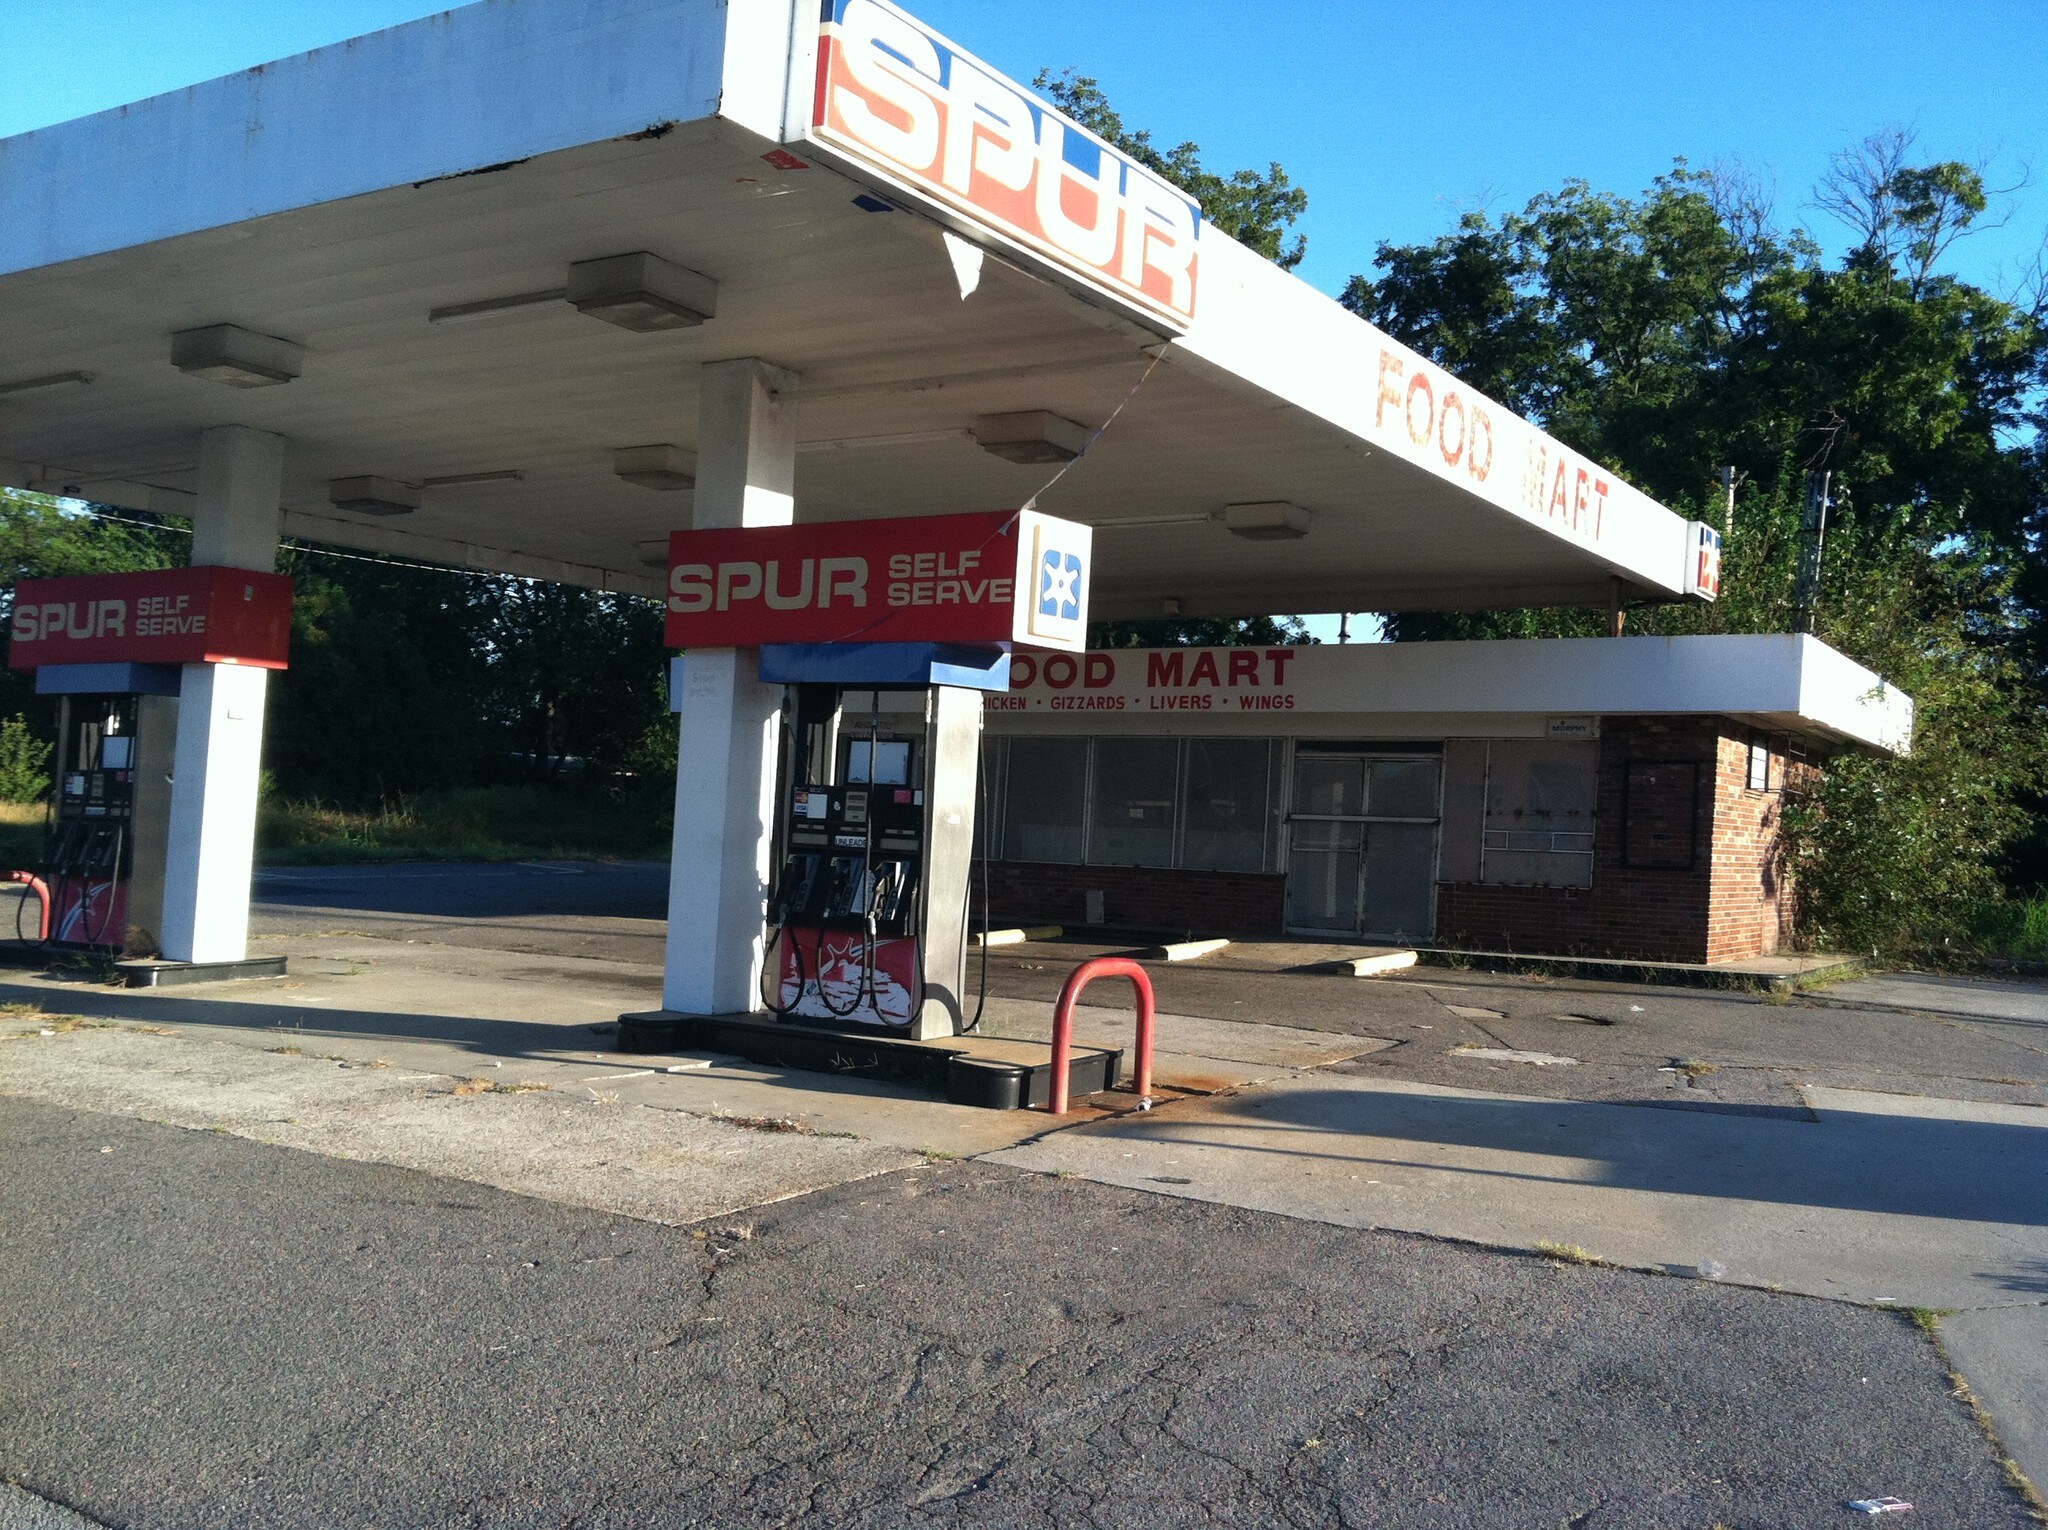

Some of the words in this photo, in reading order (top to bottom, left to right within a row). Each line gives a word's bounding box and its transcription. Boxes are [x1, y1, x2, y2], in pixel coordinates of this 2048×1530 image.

[833, 0, 1195, 317] SPUR
[1375, 349, 1493, 482] FOOD
[888, 550, 982, 579] SELF
[669, 557, 869, 613] SPUR
[887, 578, 1014, 607] SERVE
[12, 600, 127, 642] SPUR
[137, 595, 189, 616] SELF
[136, 615, 206, 637] SERVE
[1009, 653, 1116, 689] OOD
[1147, 649, 1295, 687] MART
[1050, 696, 1126, 710] GIZZARDS
[1150, 694, 1213, 710] LIVERS
[1239, 694, 1295, 709] WINGS
